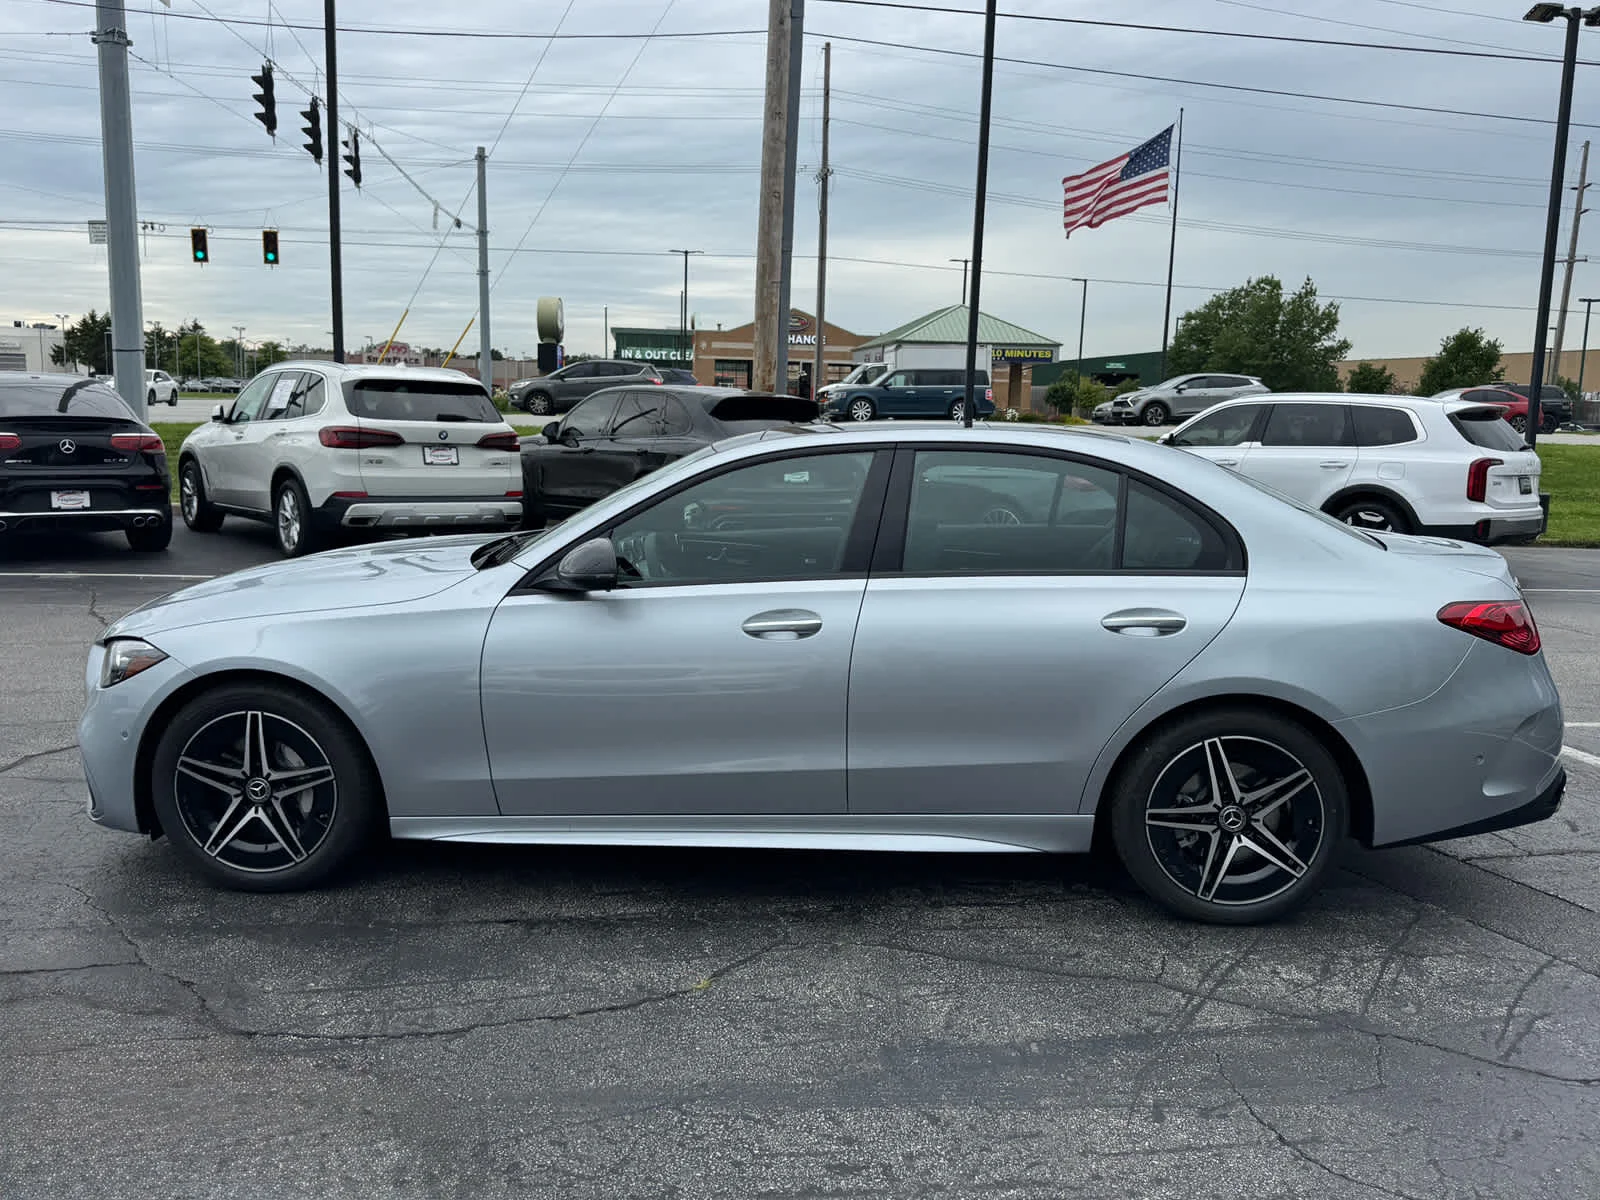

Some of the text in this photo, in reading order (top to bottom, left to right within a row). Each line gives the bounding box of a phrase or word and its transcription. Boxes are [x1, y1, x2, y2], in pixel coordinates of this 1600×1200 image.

[621, 349, 632, 359] IN
[635, 349, 642, 359] &
[645, 350, 667, 360] OUT
[1005, 349, 1051, 358] MINUTES
